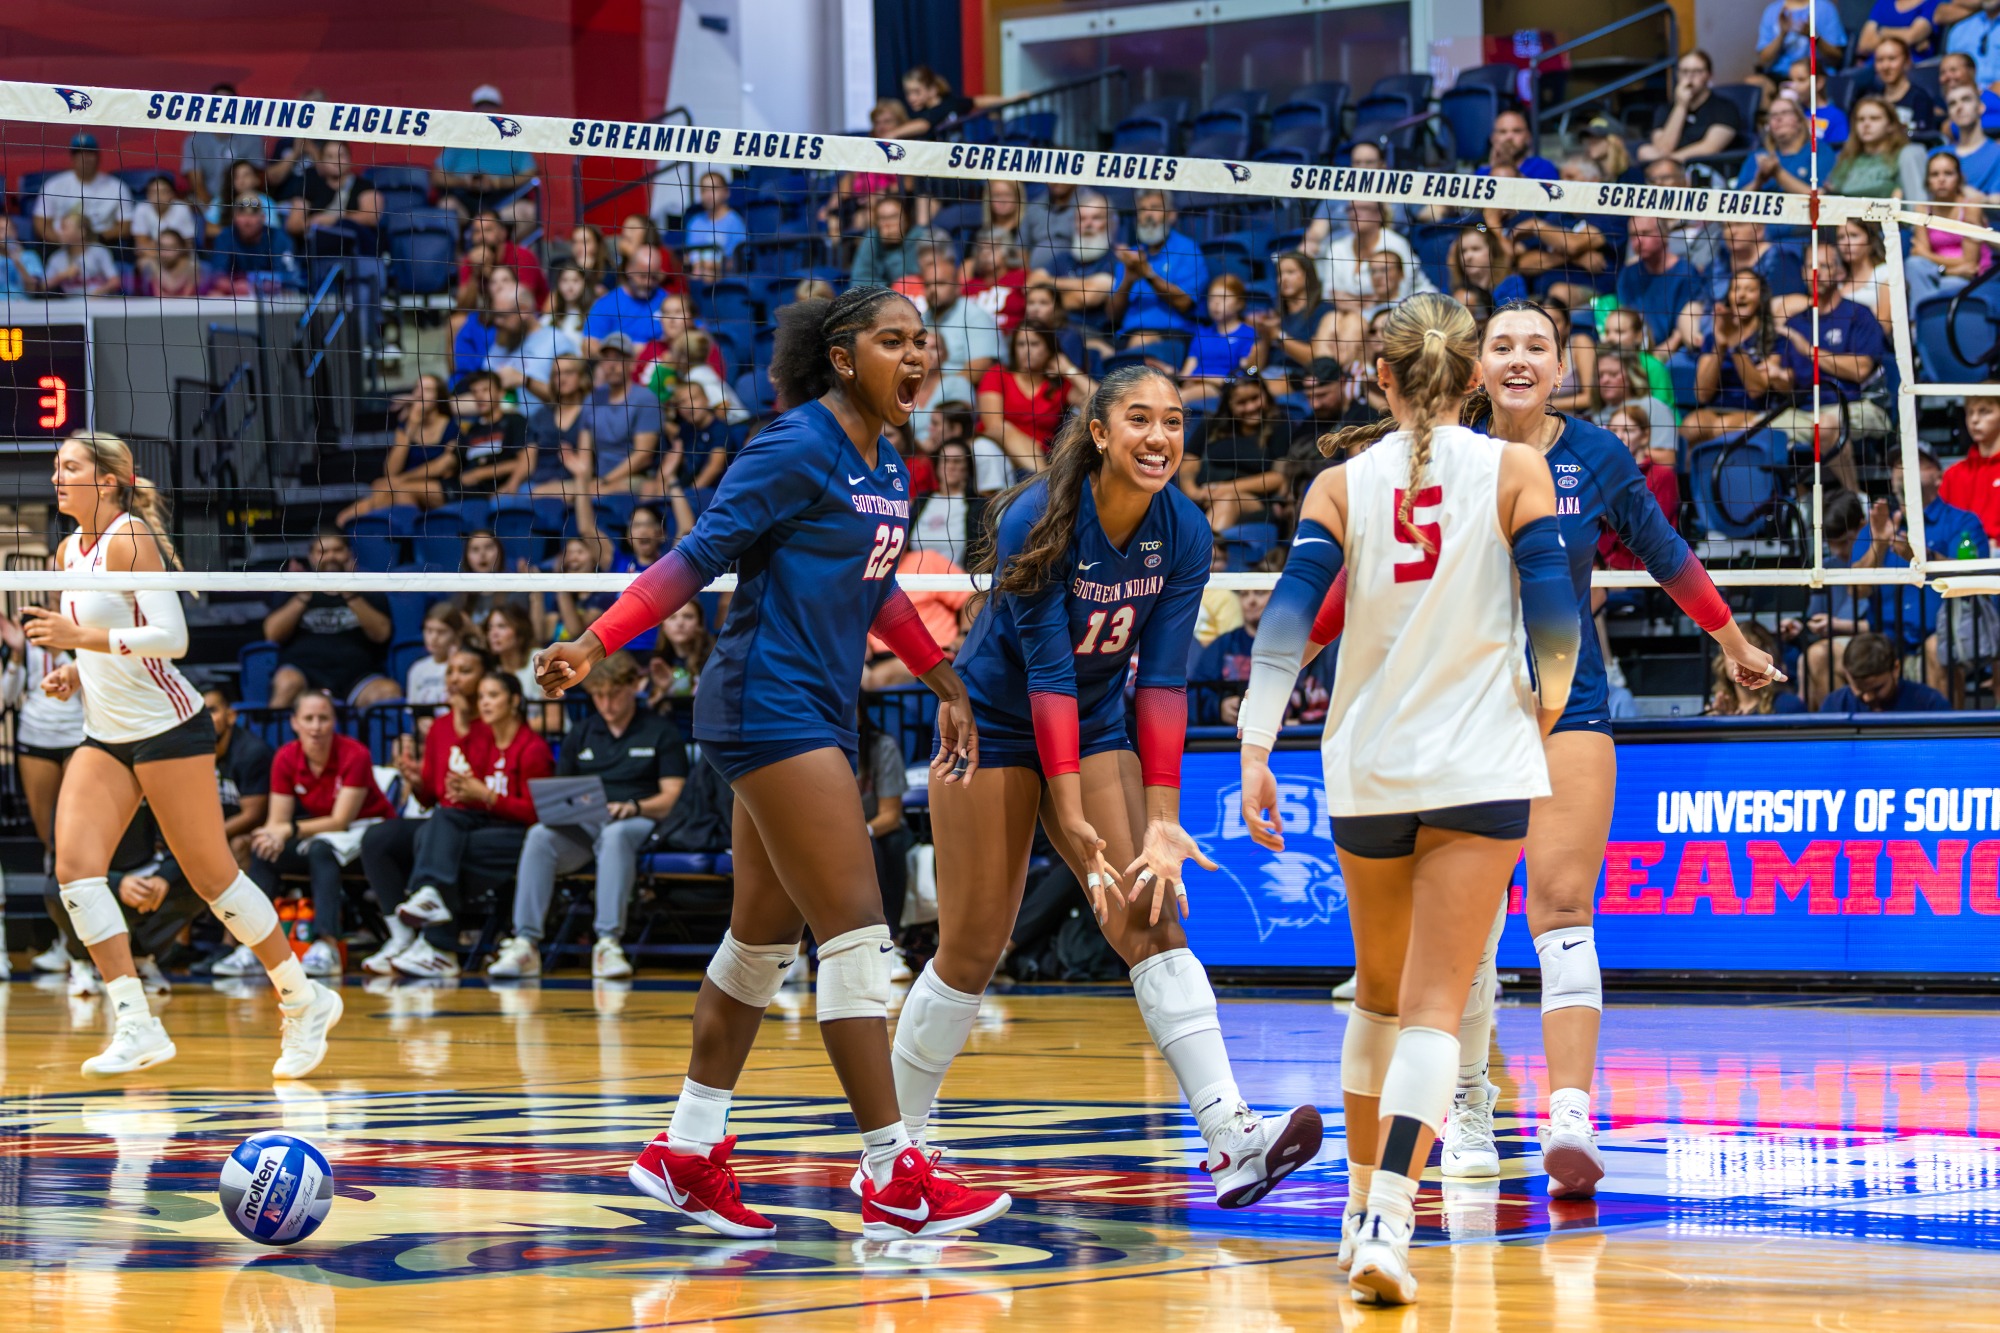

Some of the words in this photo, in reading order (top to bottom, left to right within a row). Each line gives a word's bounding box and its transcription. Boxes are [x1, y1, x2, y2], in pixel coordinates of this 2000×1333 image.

[147, 94, 315, 129] SCREAMING
[329, 106, 430, 136] EAGLES
[569, 121, 721, 153] SCREAMING
[733, 131, 824, 160] EAGLES
[948, 145, 1084, 176] SCREAMING
[1095, 154, 1178, 181] EAGLES
[1290, 167, 1414, 195] SCREAMING
[1422, 174, 1497, 200] EAGLES
[1597, 185, 1708, 212] SCREAMING
[1717, 192, 1785, 217] EAGLES
[38, 375, 66, 428] 3
[1555, 464, 1577, 473] TCG
[1555, 496, 1580, 515] ANA
[862, 522, 905, 580] 22
[1140, 541, 1159, 551] TCG
[1394, 485, 1443, 584] 5
[1073, 577, 1121, 603] SOUTHERN
[1123, 576, 1164, 599] INDIANA
[1074, 604, 1136, 654] 13
[1657, 789, 1846, 834] UNIVERSITY
[1855, 789, 1896, 832] OF
[1592, 839, 2000, 916] EAMIN
[244, 1159, 278, 1220] molten
[263, 1171, 297, 1223] NCAA
